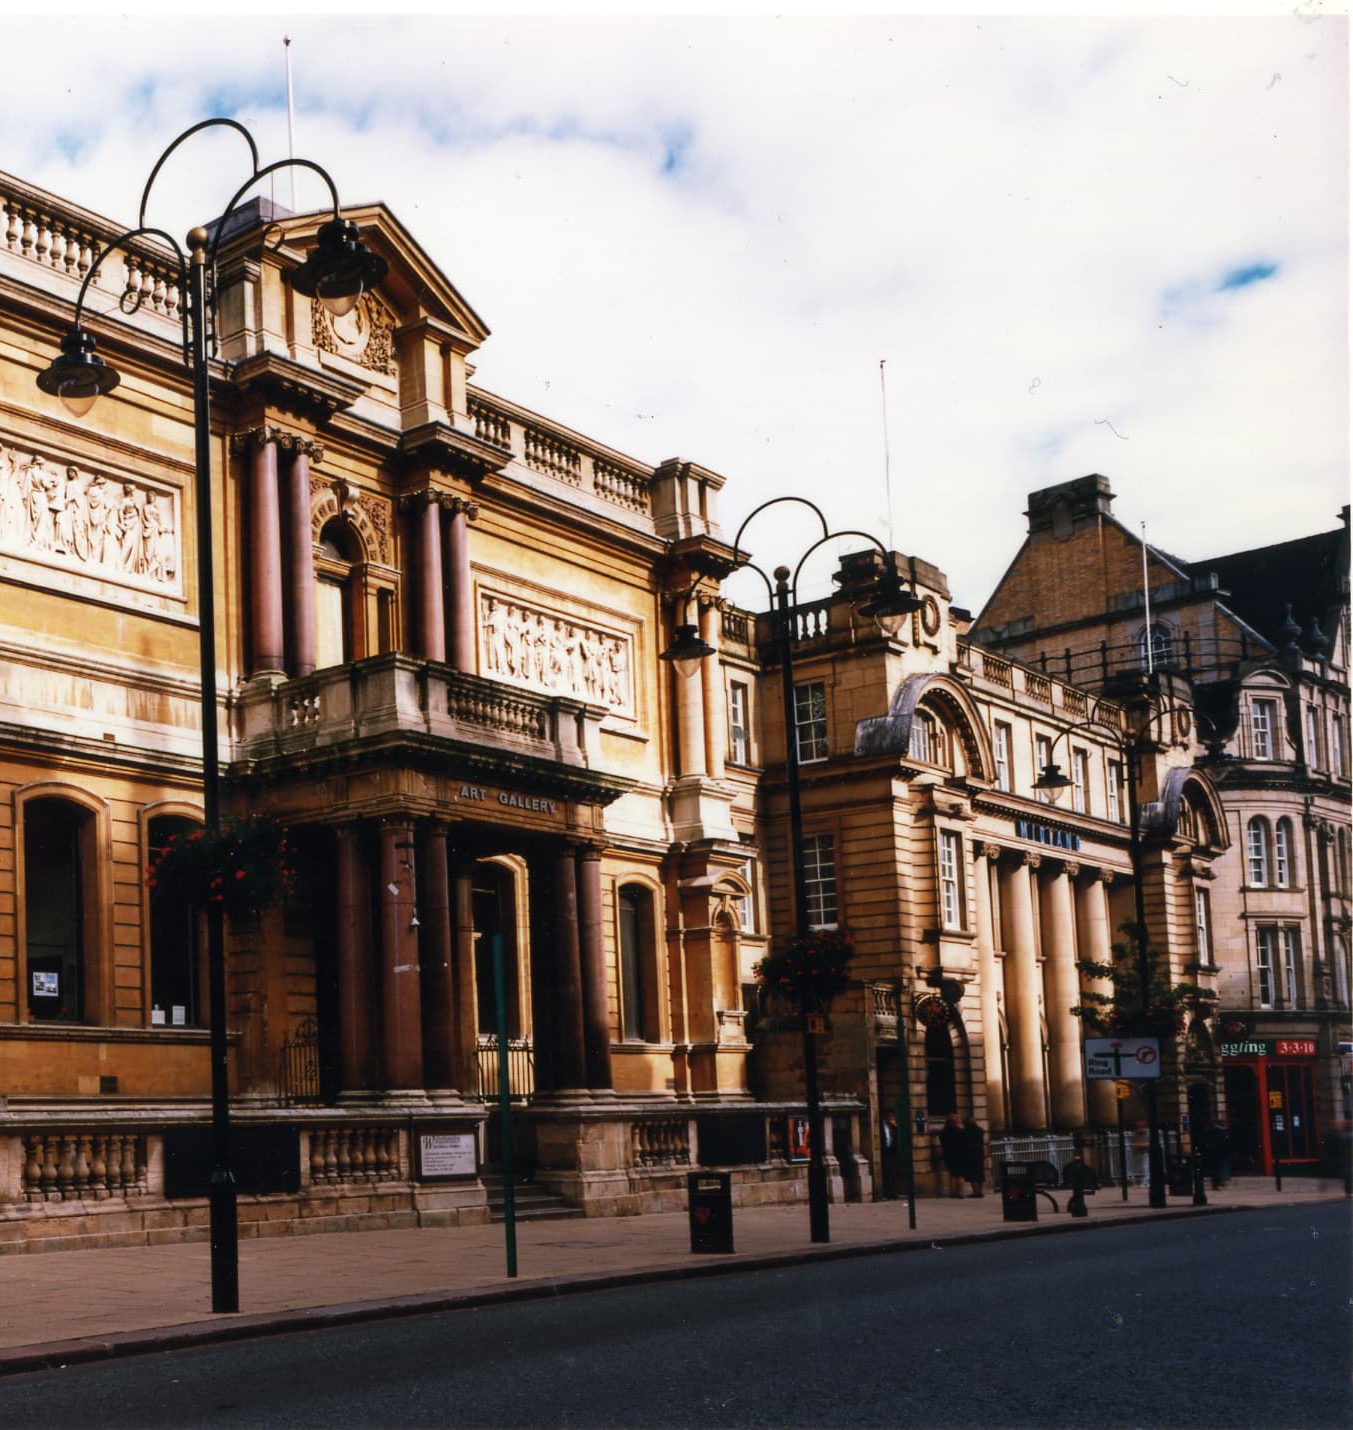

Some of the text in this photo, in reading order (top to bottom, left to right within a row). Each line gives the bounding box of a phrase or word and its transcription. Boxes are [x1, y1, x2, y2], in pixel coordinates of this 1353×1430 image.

[461, 785, 556, 813] ART GALLERY
[1088, 1067, 1112, 1075] Road
